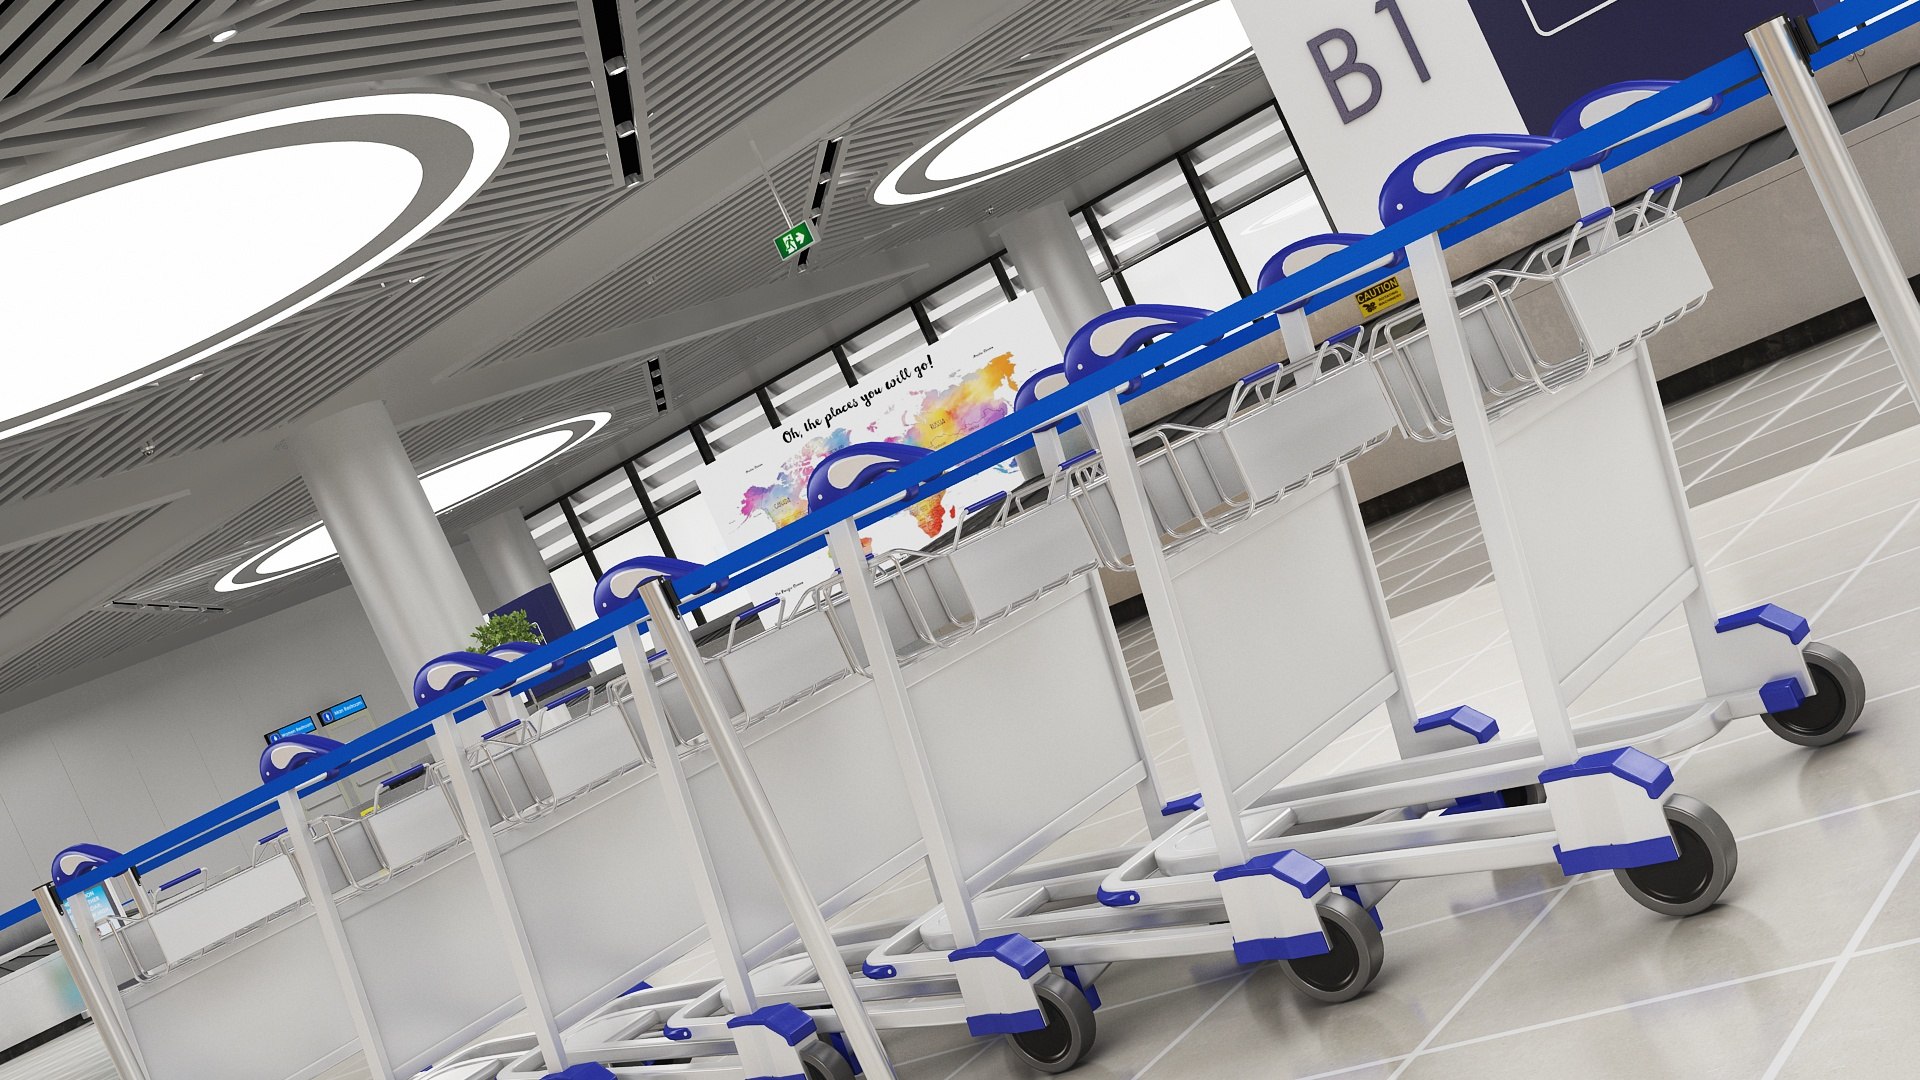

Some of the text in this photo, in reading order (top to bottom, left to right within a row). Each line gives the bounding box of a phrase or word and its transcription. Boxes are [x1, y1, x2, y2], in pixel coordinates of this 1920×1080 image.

[1306, 0, 1431, 125] B1
[1357, 278, 1398, 303] CAUTION
[782, 354, 934, 444] Oh, the places you will go!
